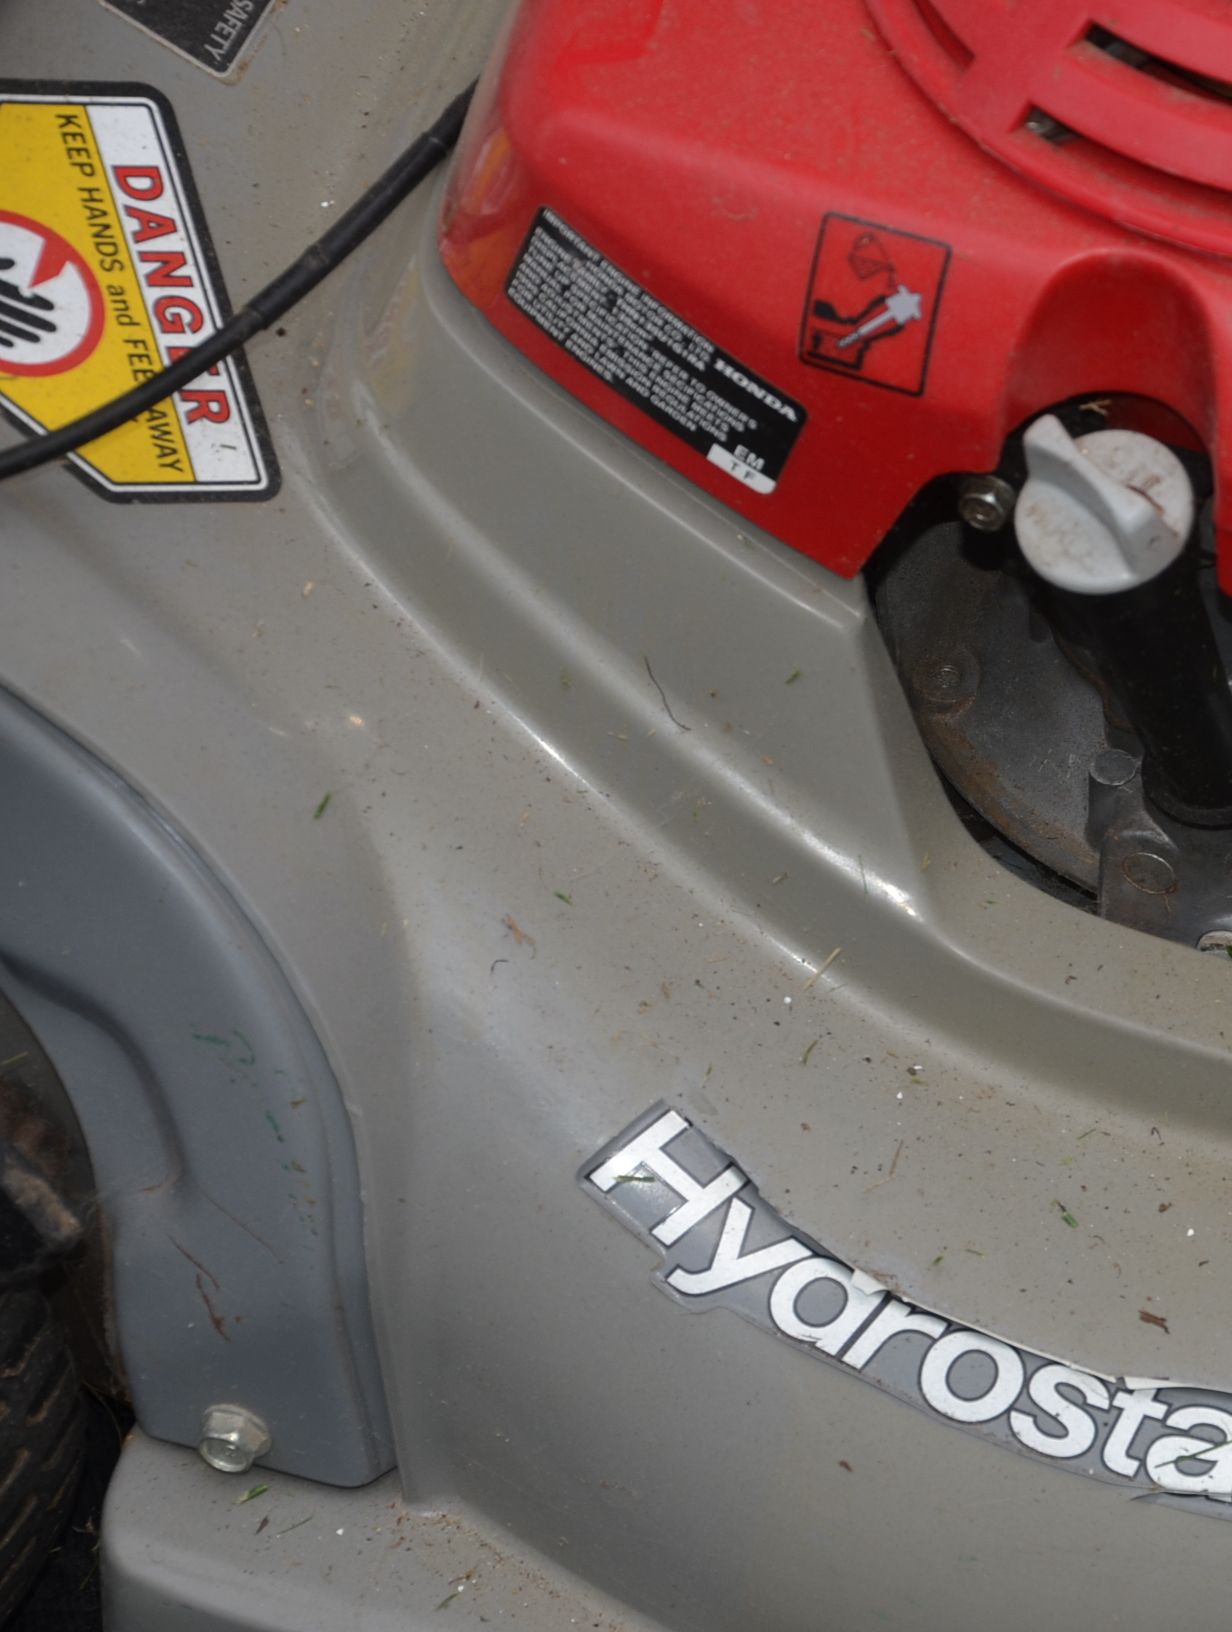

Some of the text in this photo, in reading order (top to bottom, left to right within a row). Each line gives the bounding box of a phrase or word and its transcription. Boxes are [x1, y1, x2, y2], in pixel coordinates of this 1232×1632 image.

[204, 0, 254, 61] SAFETY
[55, 114, 95, 178] KEEP
[77, 184, 123, 273] HANDS
[106, 283, 138, 327] and
[145, 406, 185, 473] AWAY
[713, 357, 799, 423] HONDA
